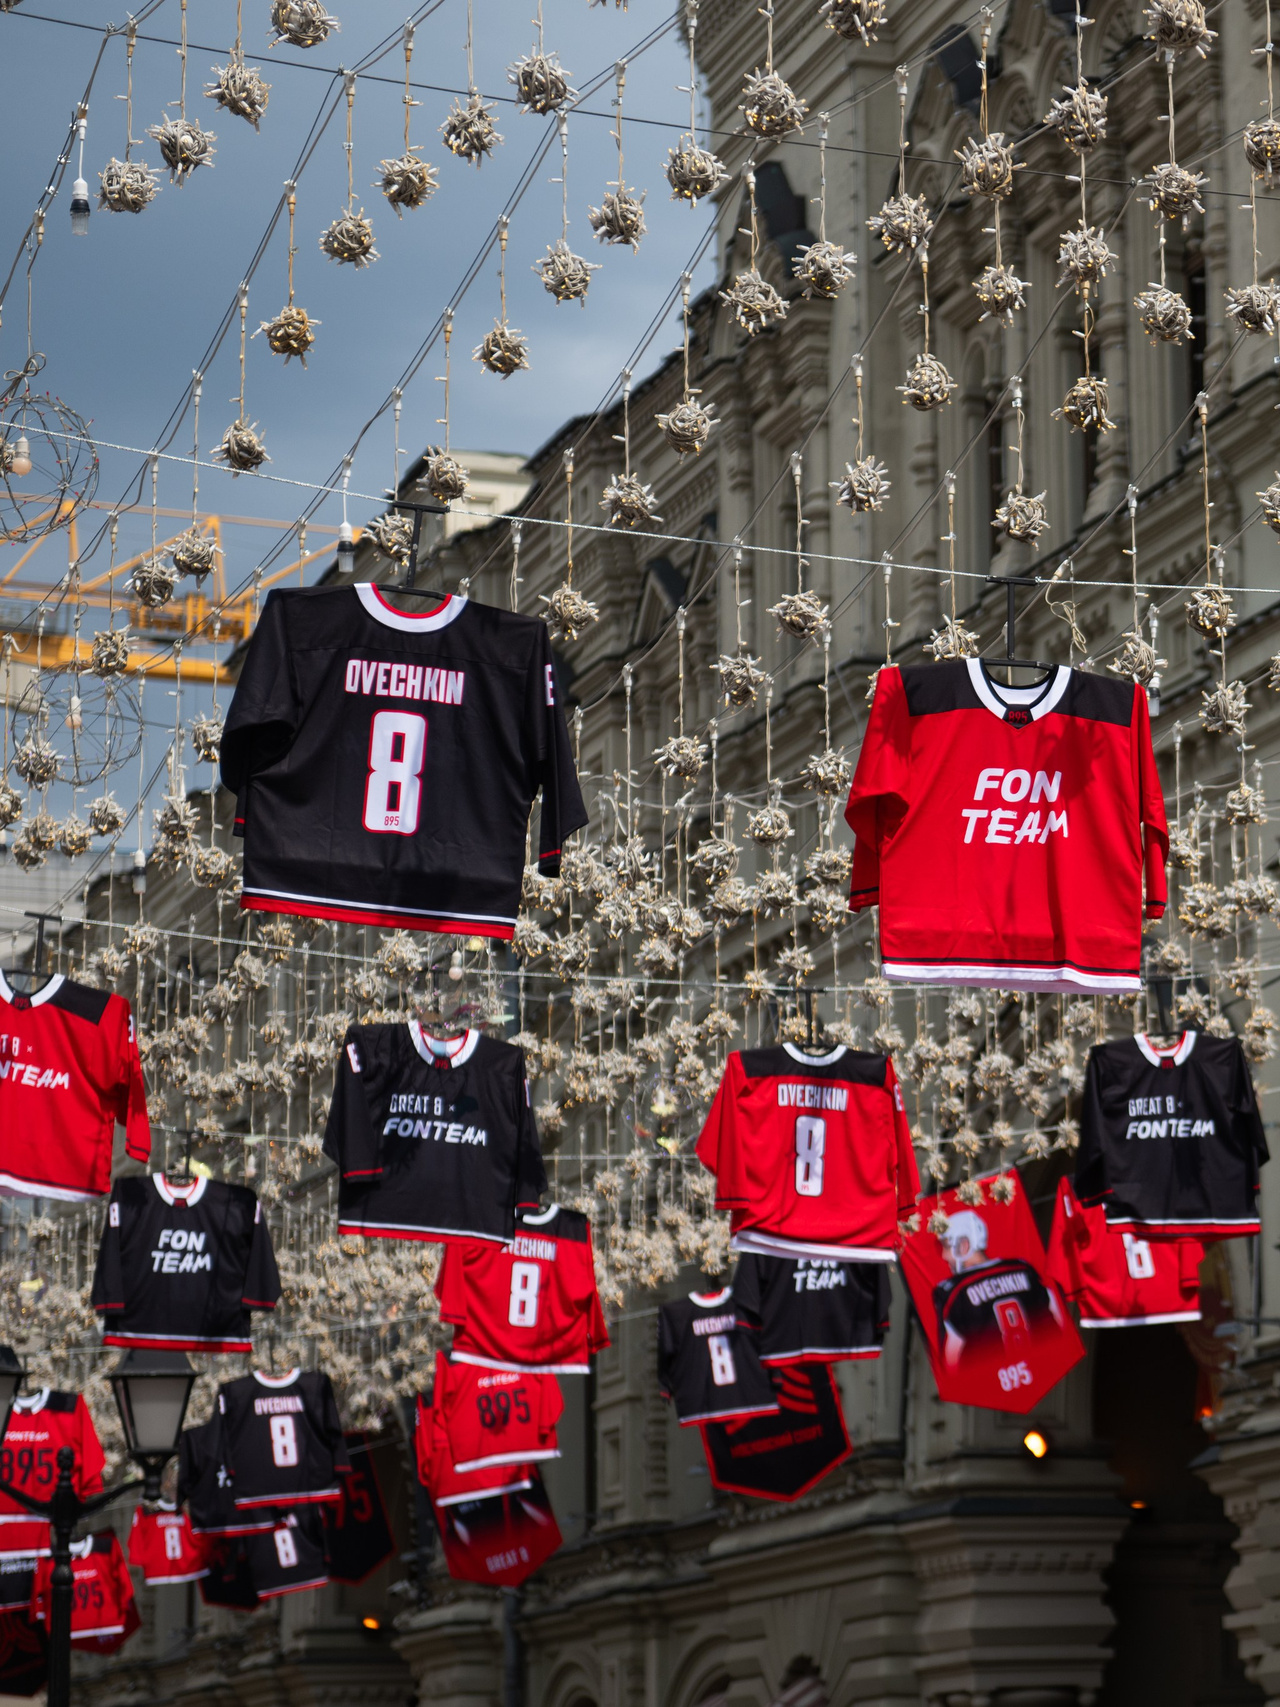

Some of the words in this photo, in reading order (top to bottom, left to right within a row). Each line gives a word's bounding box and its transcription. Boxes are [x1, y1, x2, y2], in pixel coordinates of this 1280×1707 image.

[344, 659, 465, 705] OVECHKIN
[1008, 711, 1028, 724] 895
[362, 709, 428, 836] 8
[973, 768, 1062, 803] FON
[384, 815, 400, 827] 895
[961, 808, 1069, 844] TEAM
[0, 1060, 70, 1090] NTEAM
[389, 1093, 430, 1115] GREAT
[434, 1096, 443, 1116] 8
[778, 1083, 848, 1111] OVECHKIN
[1128, 1096, 1163, 1117] GREAT
[1166, 1095, 1175, 1114] 8
[382, 1117, 488, 1147] FONTEAM
[1126, 1119, 1216, 1140] FONTEAM
[795, 1115, 826, 1197] 8
[158, 1229, 206, 1252] FON
[151, 1250, 212, 1274] TEAM
[508, 1261, 540, 1328] 8
[793, 1269, 847, 1293] TEAM
[966, 1272, 1030, 1306] OVECHKIN
[708, 1335, 737, 1386] 8
[997, 1361, 1033, 1391] 895
[476, 1388, 531, 1428] 895
[270, 1415, 298, 1467] 8
[0, 1447, 53, 1484] 895
[164, 1527, 182, 1560] 8
[274, 1528, 299, 1568] 8
[71, 1580, 105, 1612] 95
